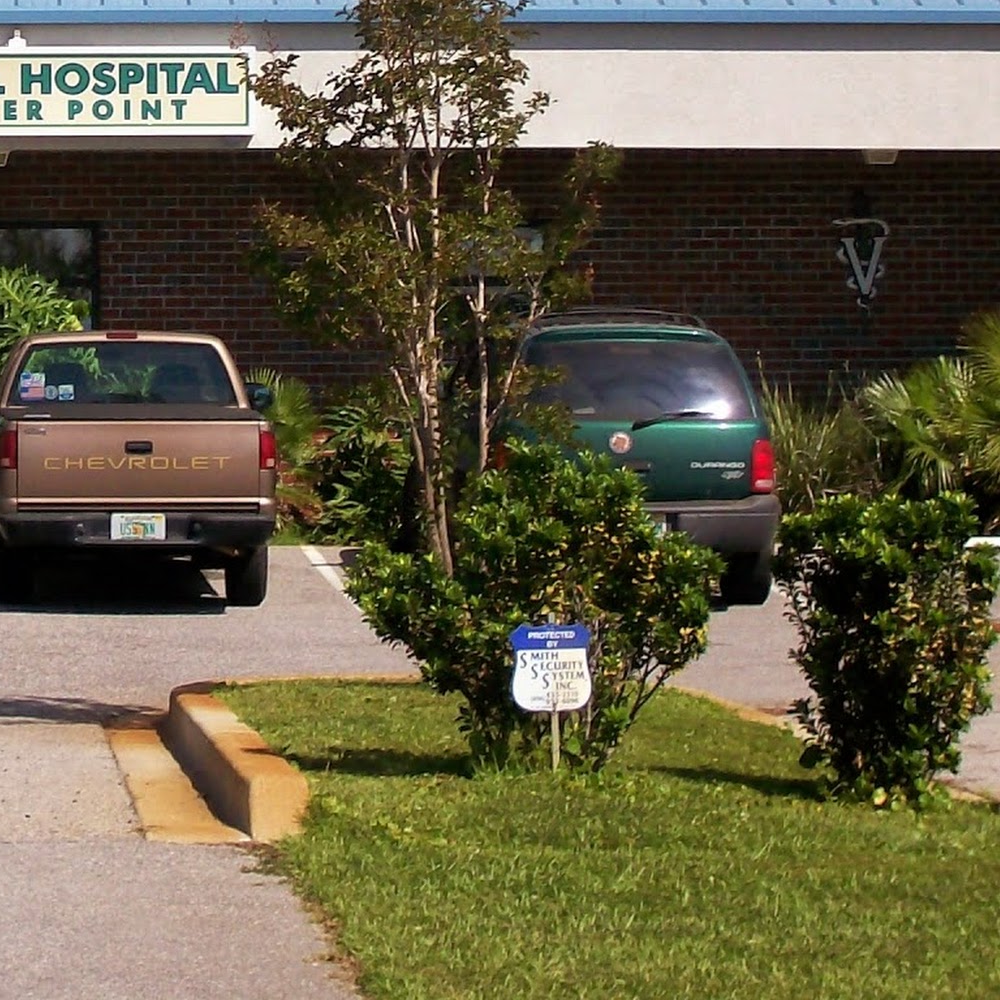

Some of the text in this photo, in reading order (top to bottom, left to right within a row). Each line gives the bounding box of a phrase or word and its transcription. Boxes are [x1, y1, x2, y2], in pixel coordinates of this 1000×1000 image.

[22, 62, 239, 95] HOSPITAL
[67, 99, 187, 121] POINT
[44, 457, 231, 470] CHEVROLET
[528, 631, 575, 639] PROTECTED
[520, 652, 559, 669] SMITH
[531, 661, 583, 679] SECURITY
